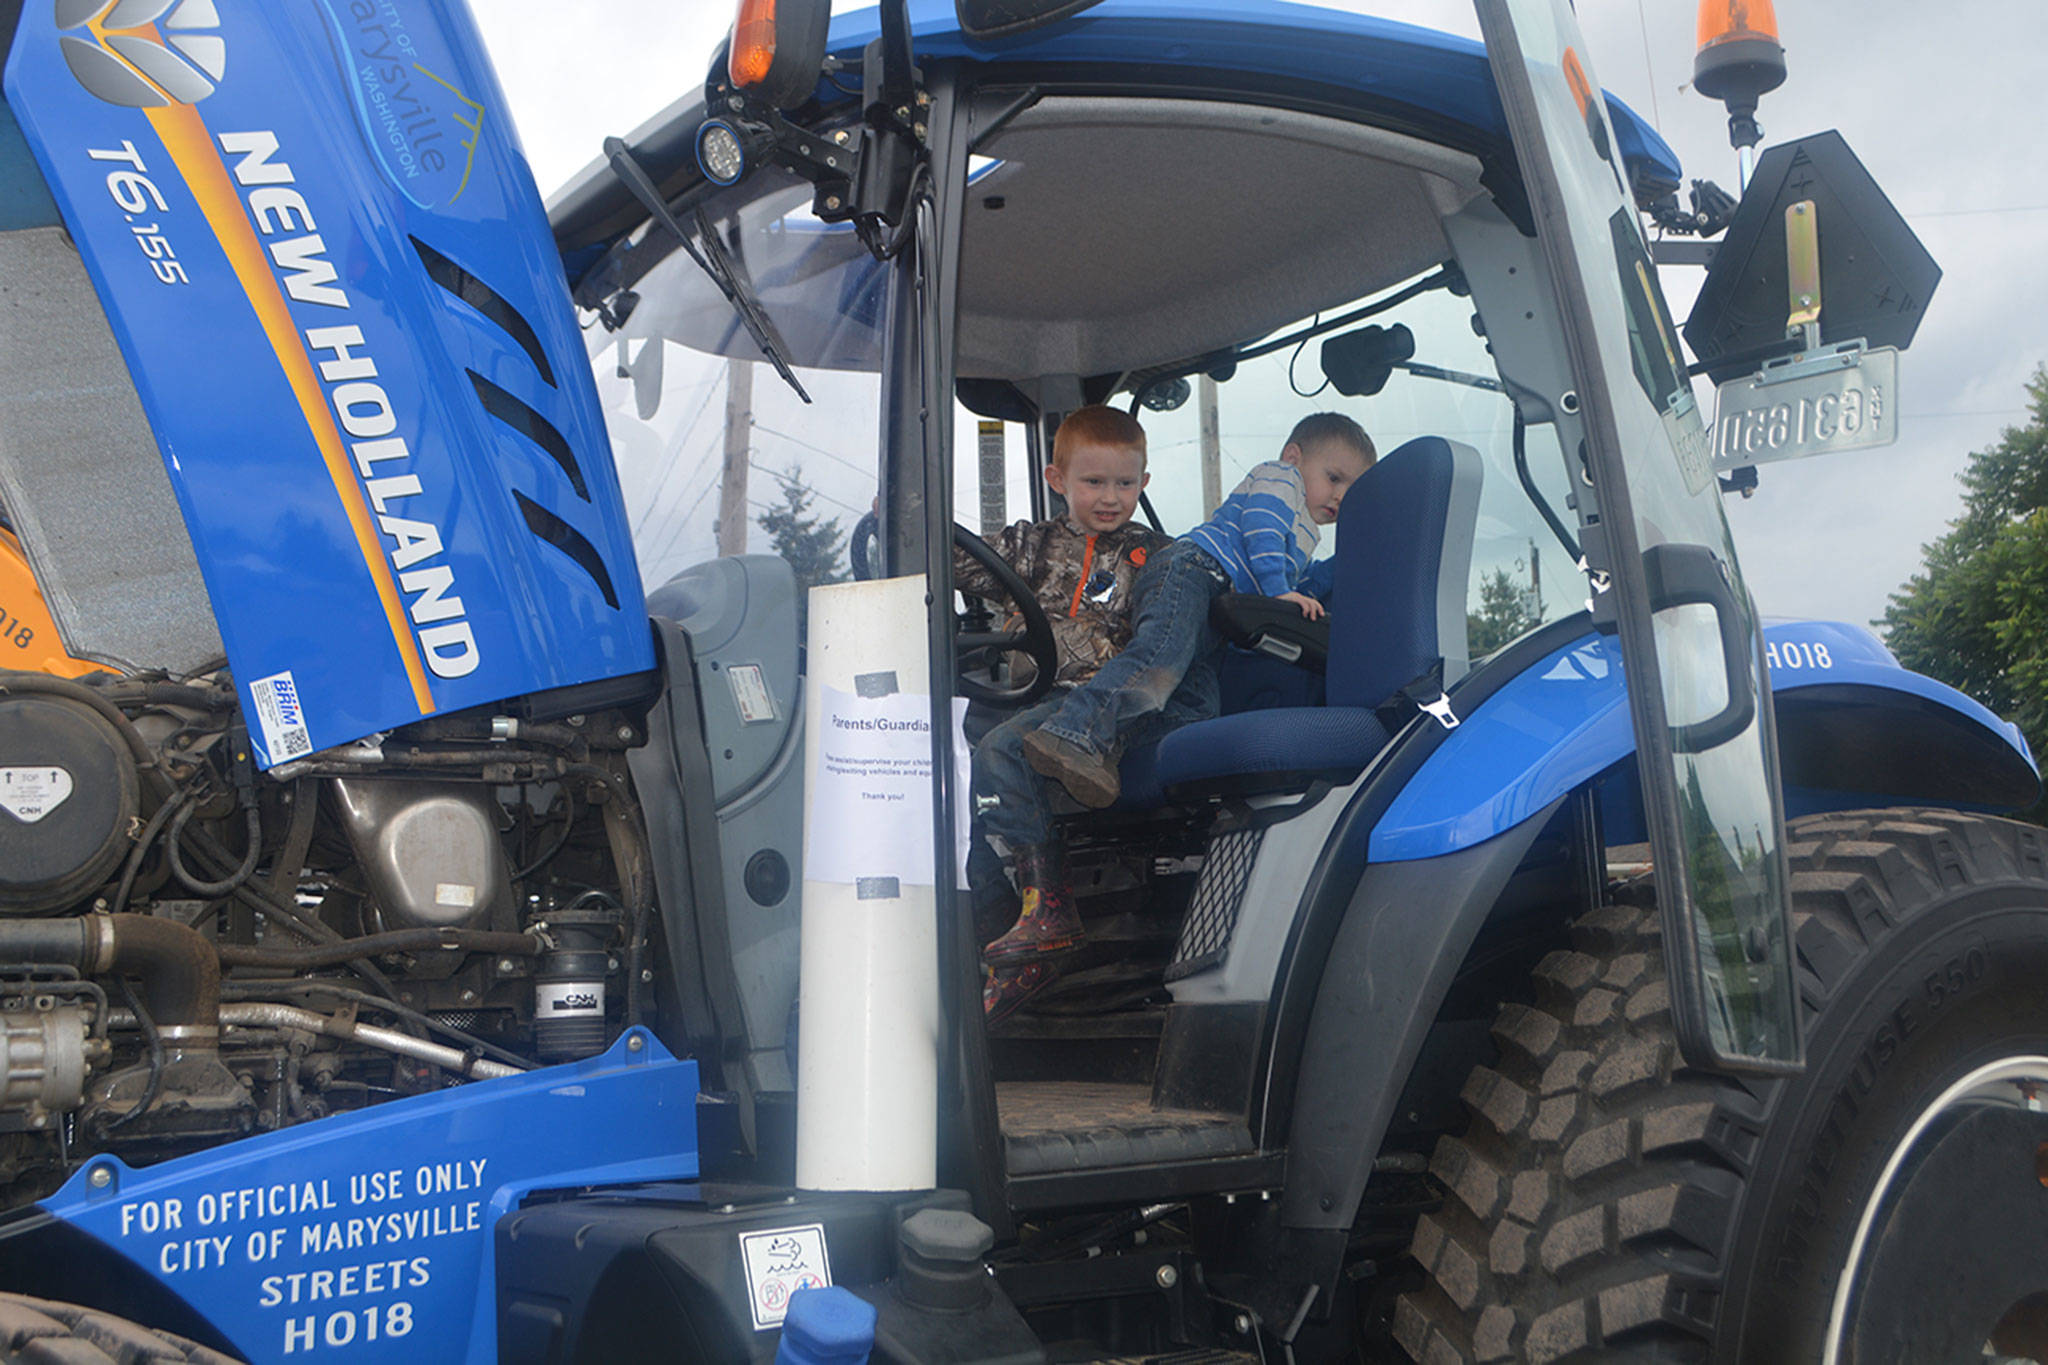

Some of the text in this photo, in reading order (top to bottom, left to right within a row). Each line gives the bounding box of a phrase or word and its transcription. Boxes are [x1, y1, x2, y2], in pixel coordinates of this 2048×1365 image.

[379, 0, 418, 57] ITY OF
[349, 0, 445, 172] arysville
[361, 65, 420, 179] WASHINGTON
[87, 139, 190, 285] T6.155
[218, 130, 480, 679] NEW HOLLAND
[273, 680, 299, 726] BRIM
[832, 713, 930, 732] Parents/Guardia
[19, 806, 42, 815] CNH
[862, 791, 905, 802] Thank you!
[565, 993, 596, 1005] CNH
[1922, 943, 1987, 1009] 550
[121, 1159, 488, 1237] FOR OFFICIAL USE ONLY
[160, 1201, 481, 1274] CITY OF MARYSVILLE
[259, 1256, 432, 1308] STREETS
